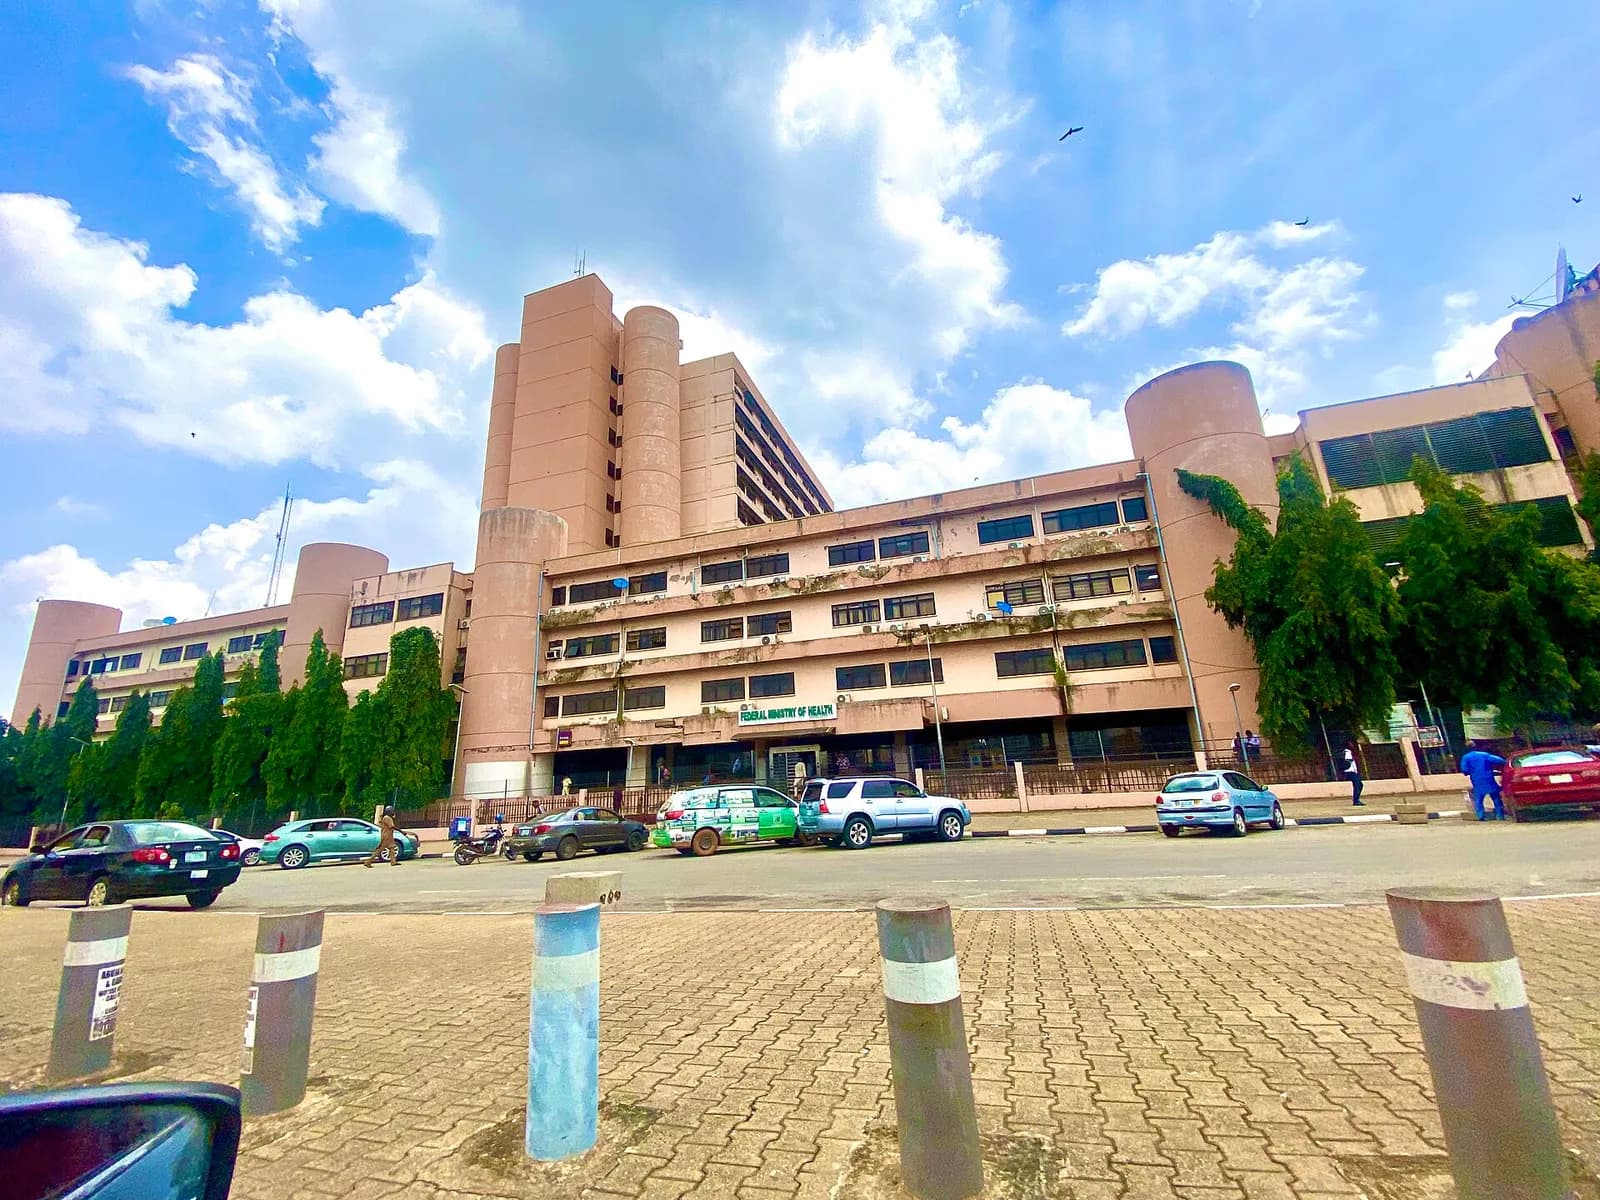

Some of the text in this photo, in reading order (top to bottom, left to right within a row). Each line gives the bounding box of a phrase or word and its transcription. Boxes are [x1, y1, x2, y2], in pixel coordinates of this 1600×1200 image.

[740, 704, 834, 722] FEDERAL MINISTRY OF HEALTH
